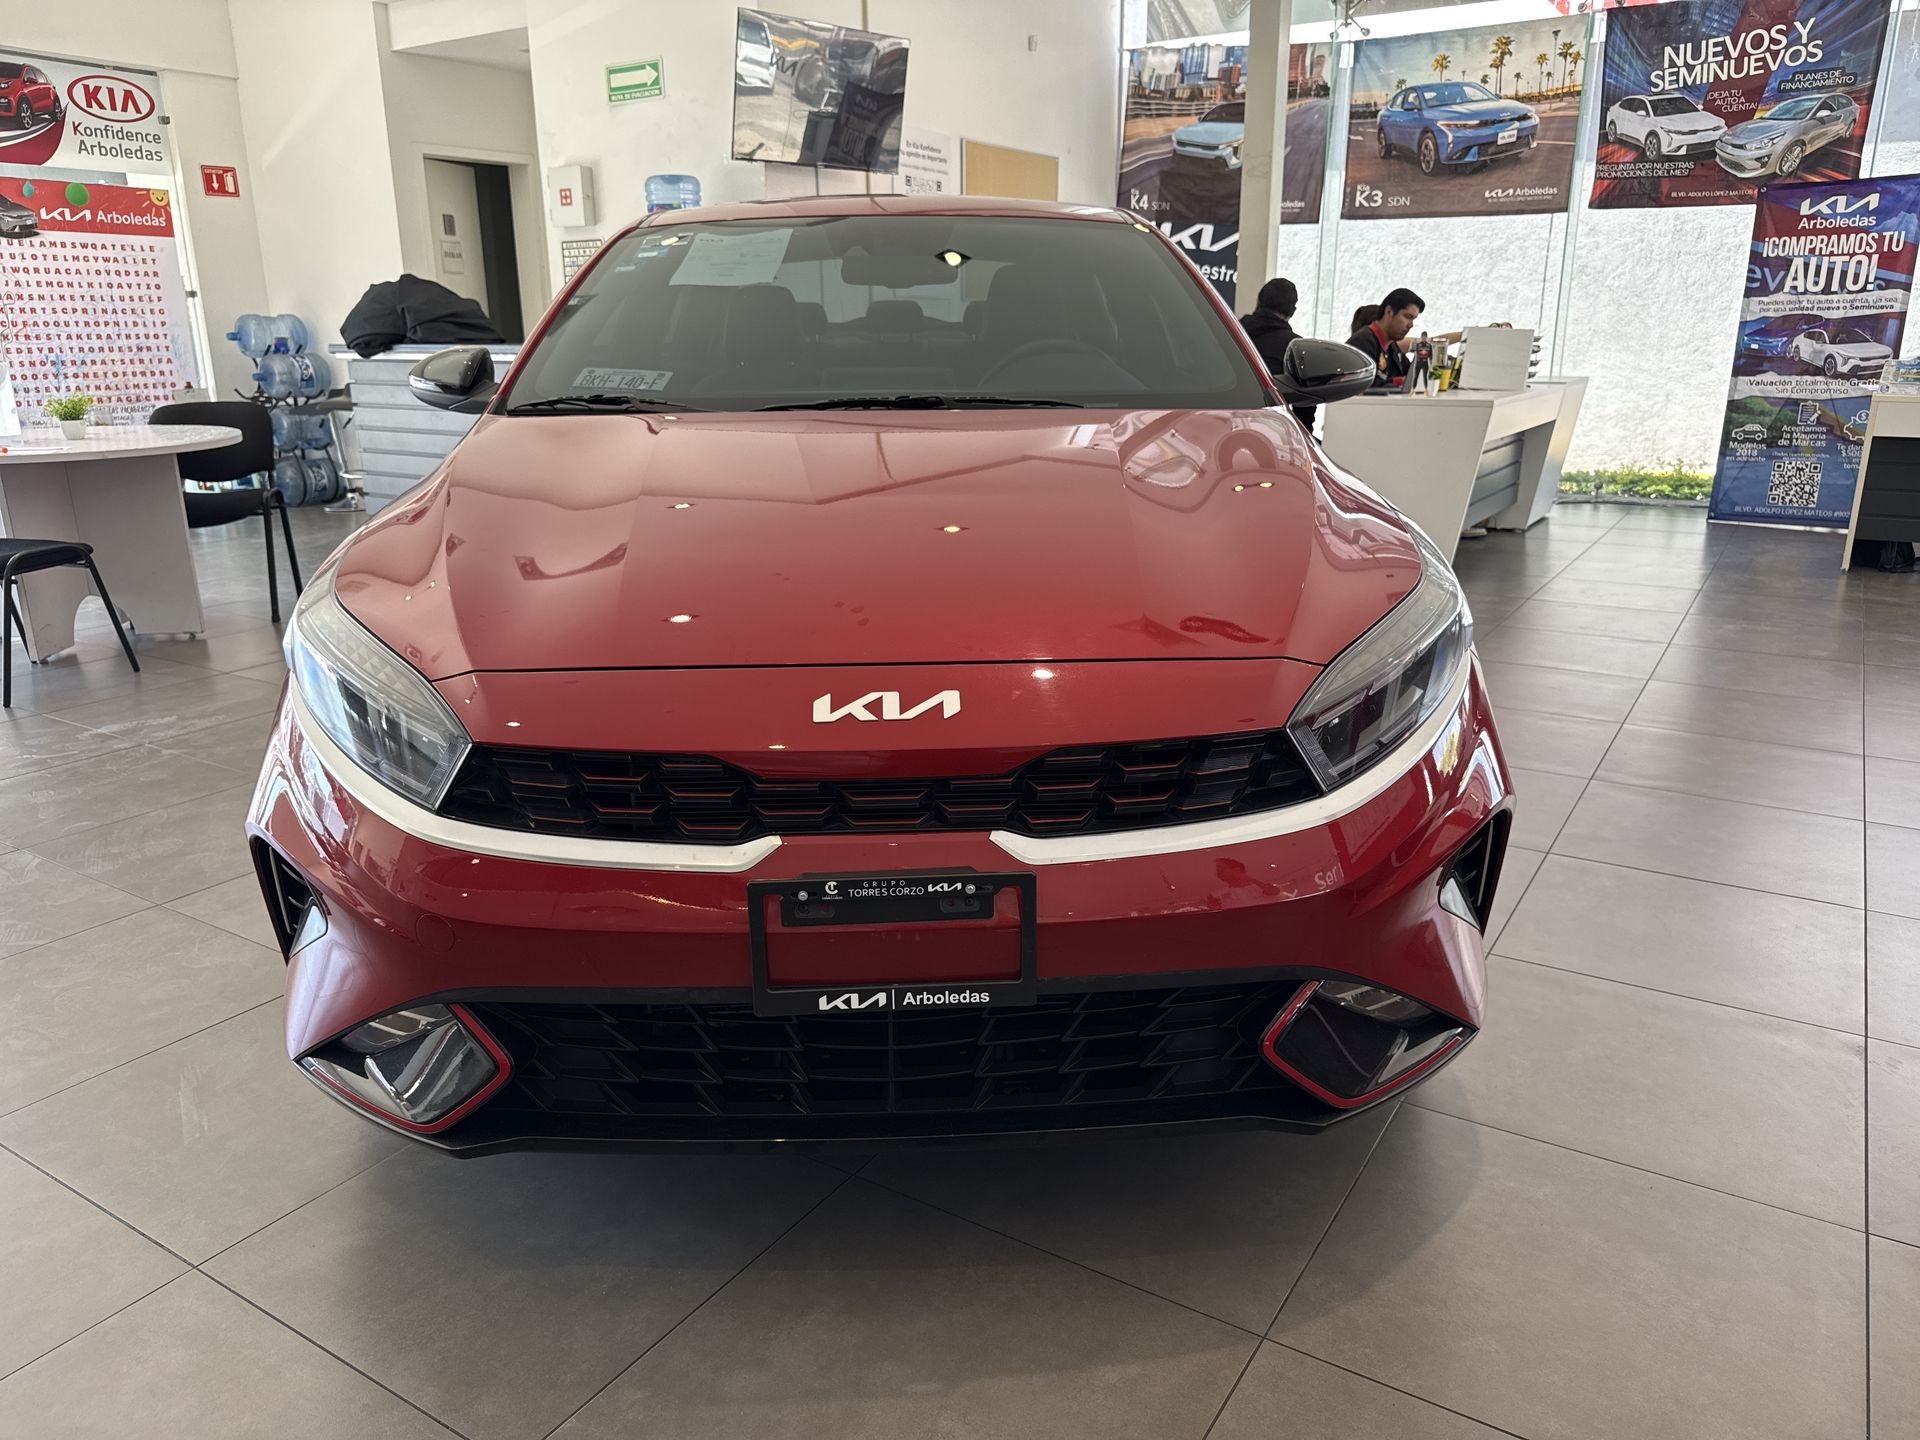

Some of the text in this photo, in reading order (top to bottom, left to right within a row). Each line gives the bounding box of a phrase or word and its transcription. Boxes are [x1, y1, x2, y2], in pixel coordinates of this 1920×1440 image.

[1664, 17, 1816, 69] NUEVOS Y
[1650, 39, 1823, 93] SEMINUEVOS
[1781, 75, 1854, 90] FINANCIAMIENTO
[1795, 70, 1842, 82] PLANES DE
[82, 84, 142, 114] KIA
[1715, 97, 1738, 105] AUTO
[72, 121, 161, 144] Konfidence
[78, 139, 163, 162] Arboledas
[1654, 169, 1669, 177] DEL
[1655, 162, 1694, 170] NUESTRAS
[1355, 190, 1382, 208] K3
[1387, 197, 1410, 206] SDN
[1485, 186, 1558, 198] KIA Arboledas
[1130, 193, 1170, 210] K4 SDN
[1800, 193, 1880, 215] KIA
[40, 207, 166, 227] KIA Arboledas
[1798, 214, 1877, 230] Arboledas
[1882, 230, 1905, 252] TU
[1783, 253, 1879, 293] AUTO!
[1849, 303, 1894, 311] Seminueva
[1791, 387, 1848, 395] Compromiso
[1795, 379, 1848, 387] totalmente
[1782, 425, 1826, 433] Aceptamos
[1729, 441, 1767, 450] Modelos
[1792, 439, 1826, 447] Marcas
[813, 689, 961, 722] KIA
[848, 887, 888, 898] TORRES
[889, 886, 925, 896] CORZO
[928, 882, 962, 893] KIA
[818, 989, 990, 1011] KIA Arboledas
